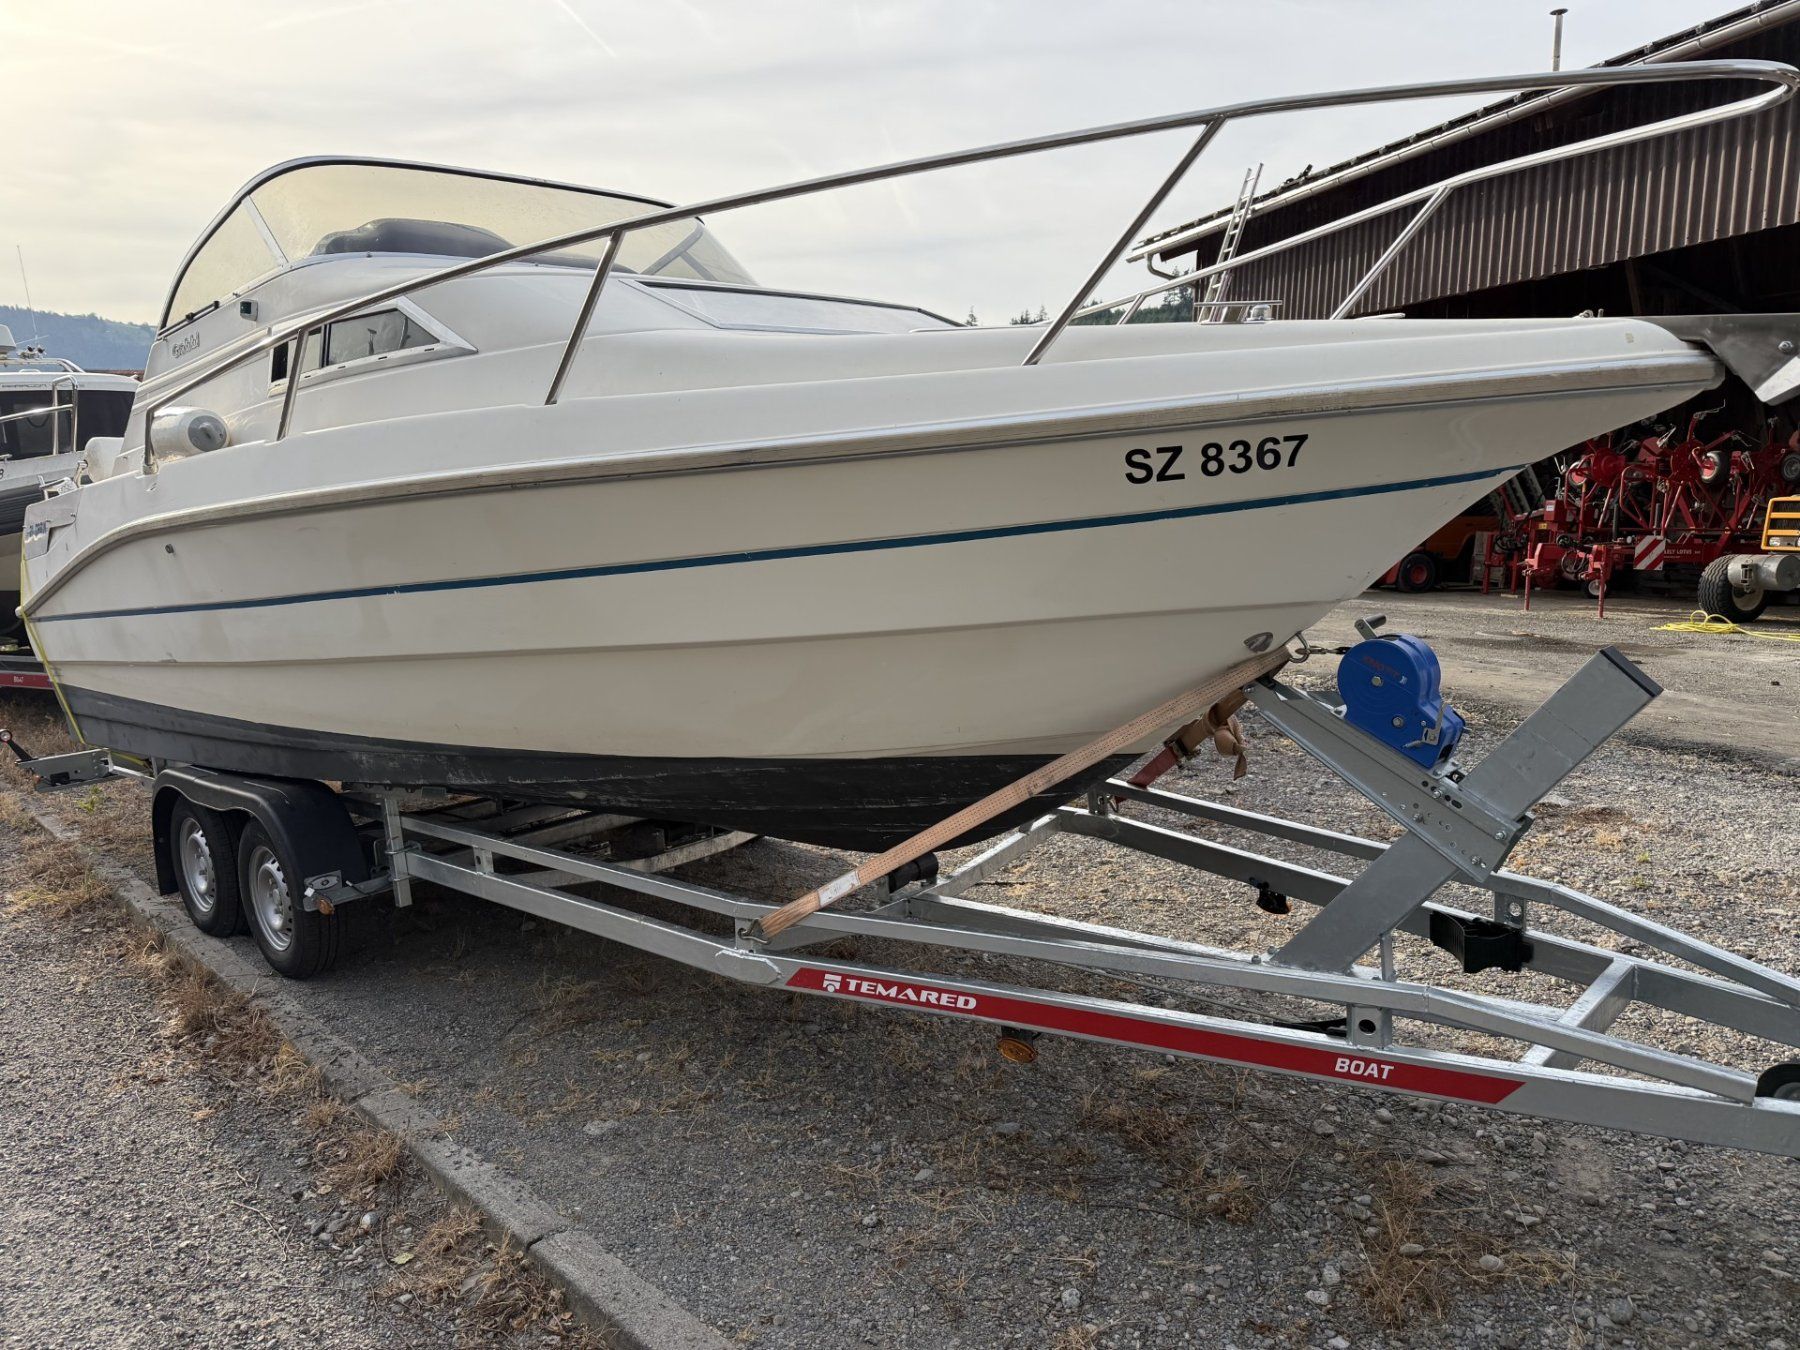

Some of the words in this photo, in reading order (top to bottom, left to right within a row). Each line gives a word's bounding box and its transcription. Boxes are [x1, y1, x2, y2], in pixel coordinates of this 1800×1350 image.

[1125, 445, 1186, 485] SZ
[1200, 434, 1309, 477] 8367
[846, 979, 976, 1010] TEMARED
[1335, 1058, 1394, 1080] BOAT
